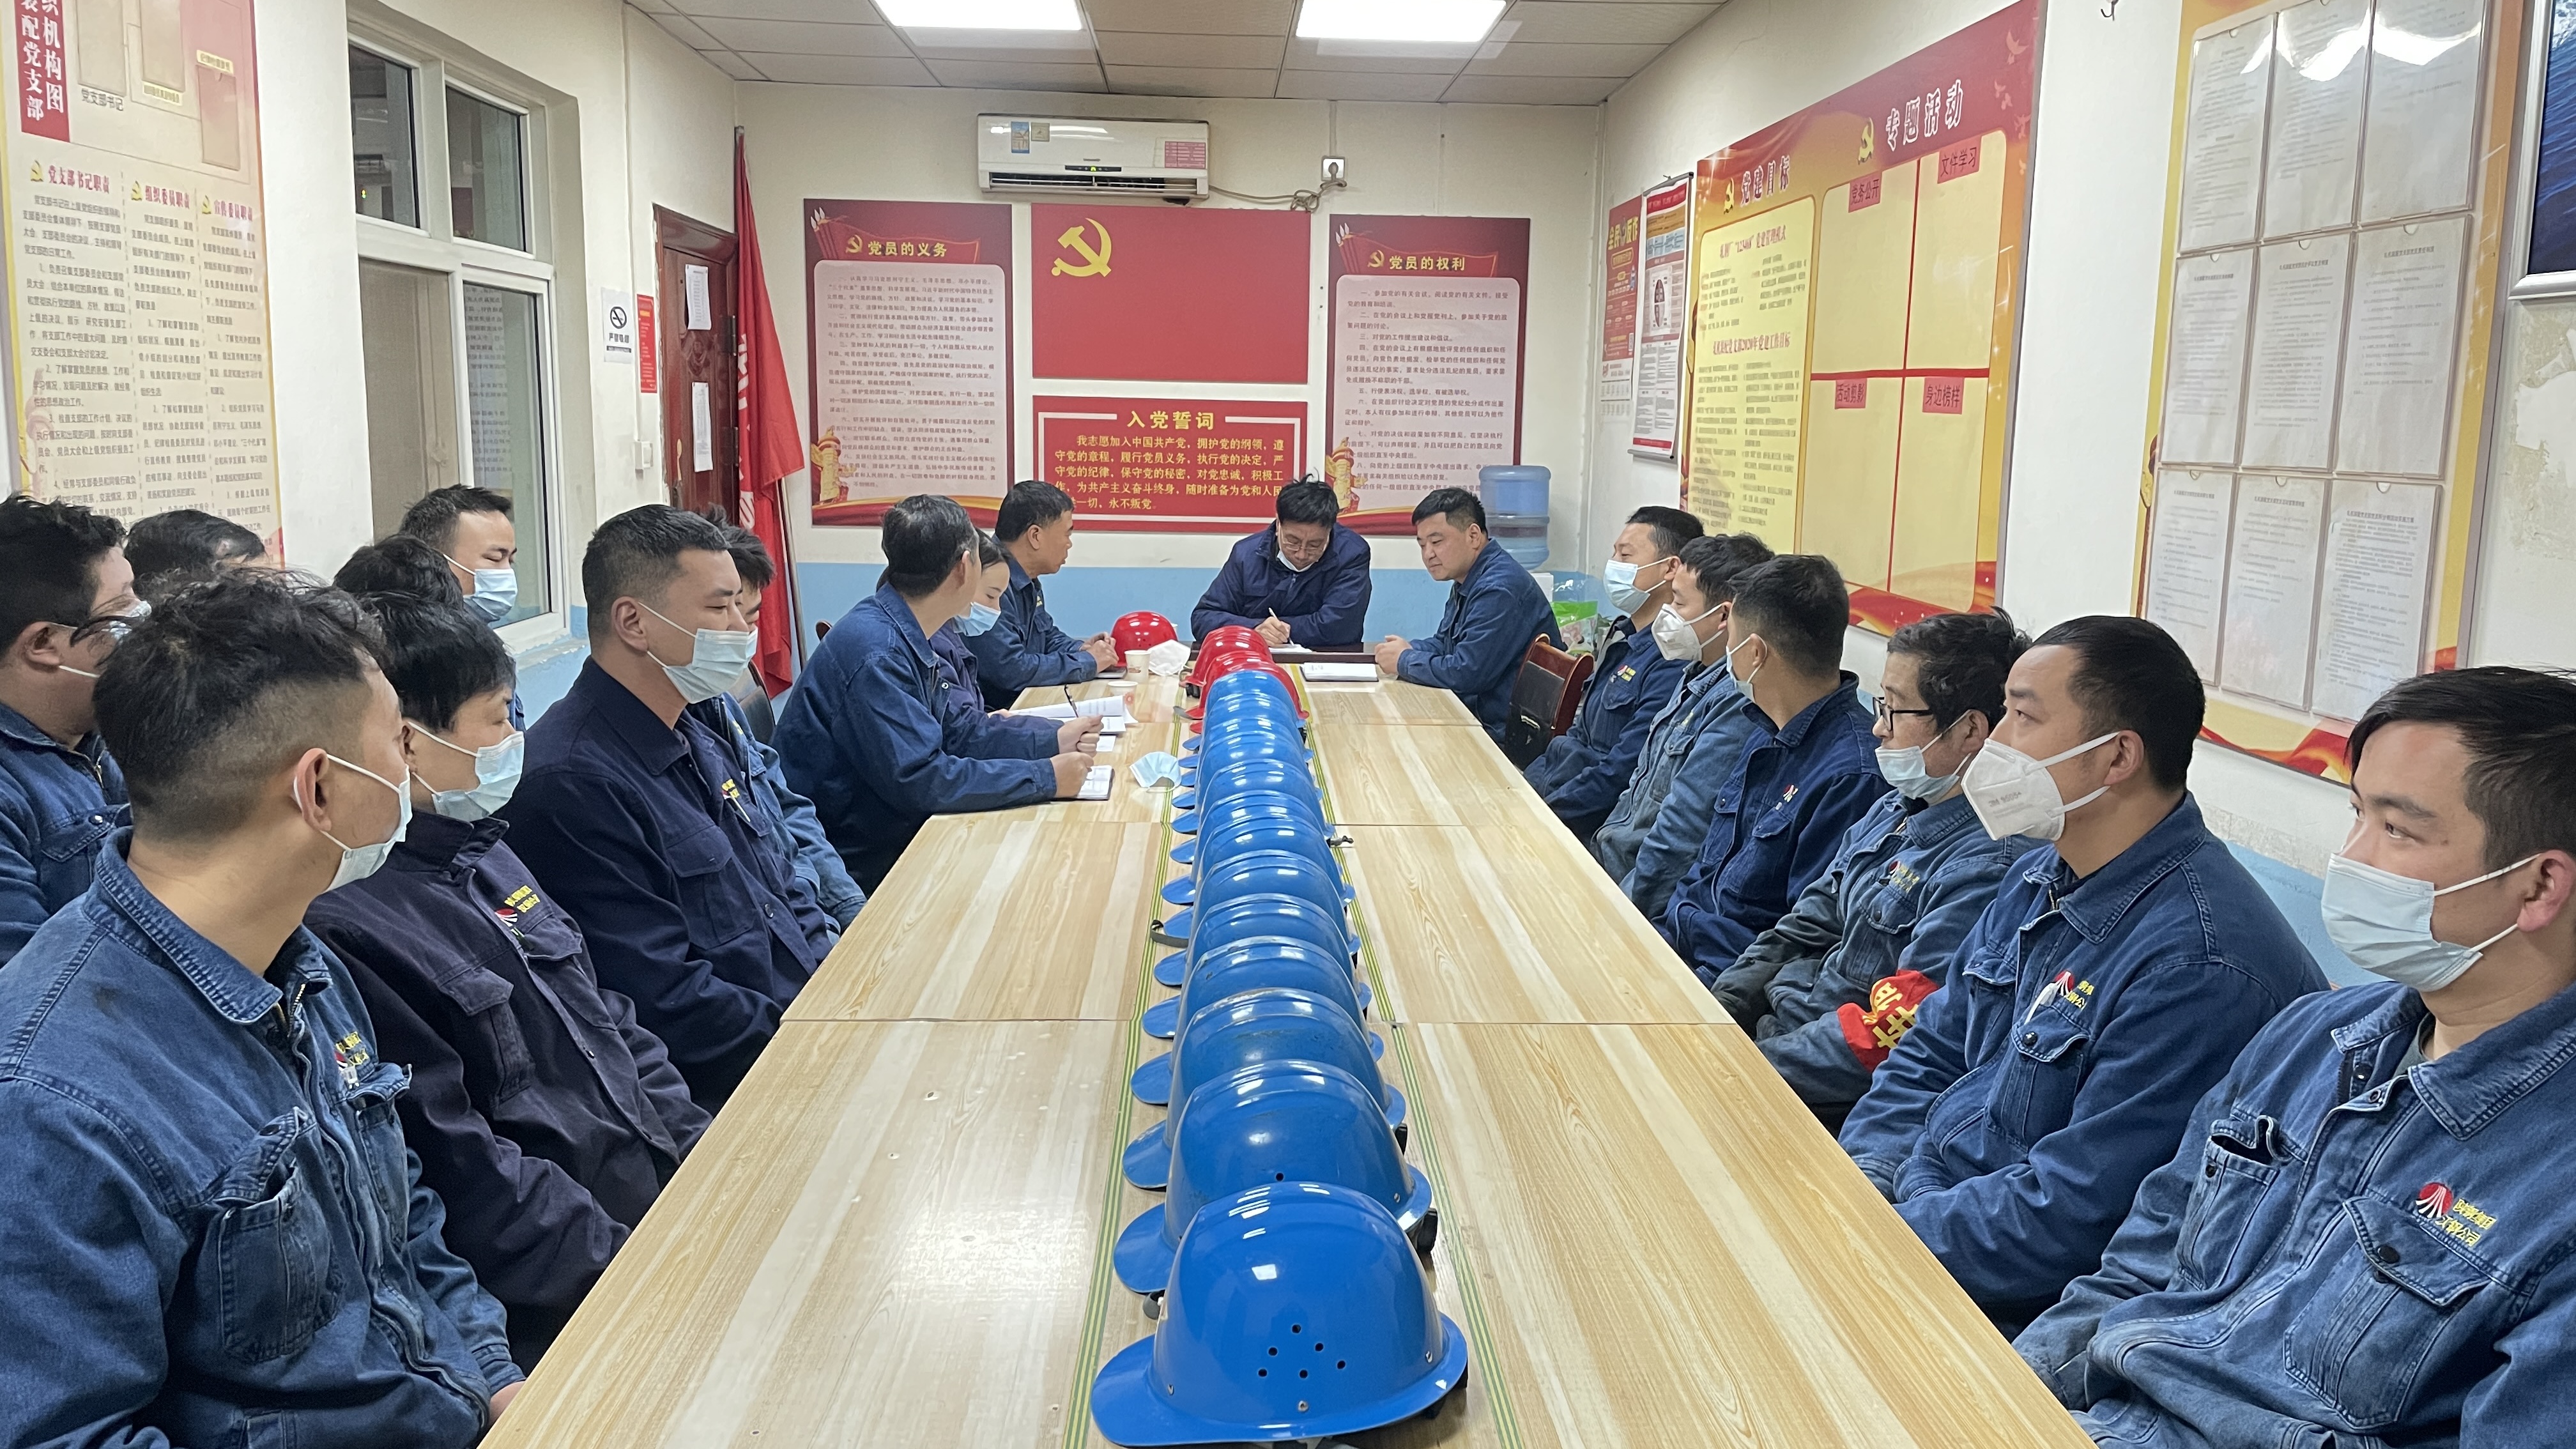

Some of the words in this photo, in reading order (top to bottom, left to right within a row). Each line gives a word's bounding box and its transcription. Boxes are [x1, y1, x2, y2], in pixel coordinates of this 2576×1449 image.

[1885, 79, 1965, 152] 专题活动
[1941, 146, 1977, 178] 文件学习
[1740, 154, 1791, 208] 党建目标
[1851, 178, 1880, 205] 党务公开
[868, 241, 947, 257] 党员的义务
[1389, 256, 1466, 271] 党员的权利
[1836, 382, 1865, 404] 活动剪影
[1925, 384, 1961, 408] 身边榜样
[1127, 410, 1215, 431] 入党誓词
[2453, 1198, 2497, 1230] 陕钢集团
